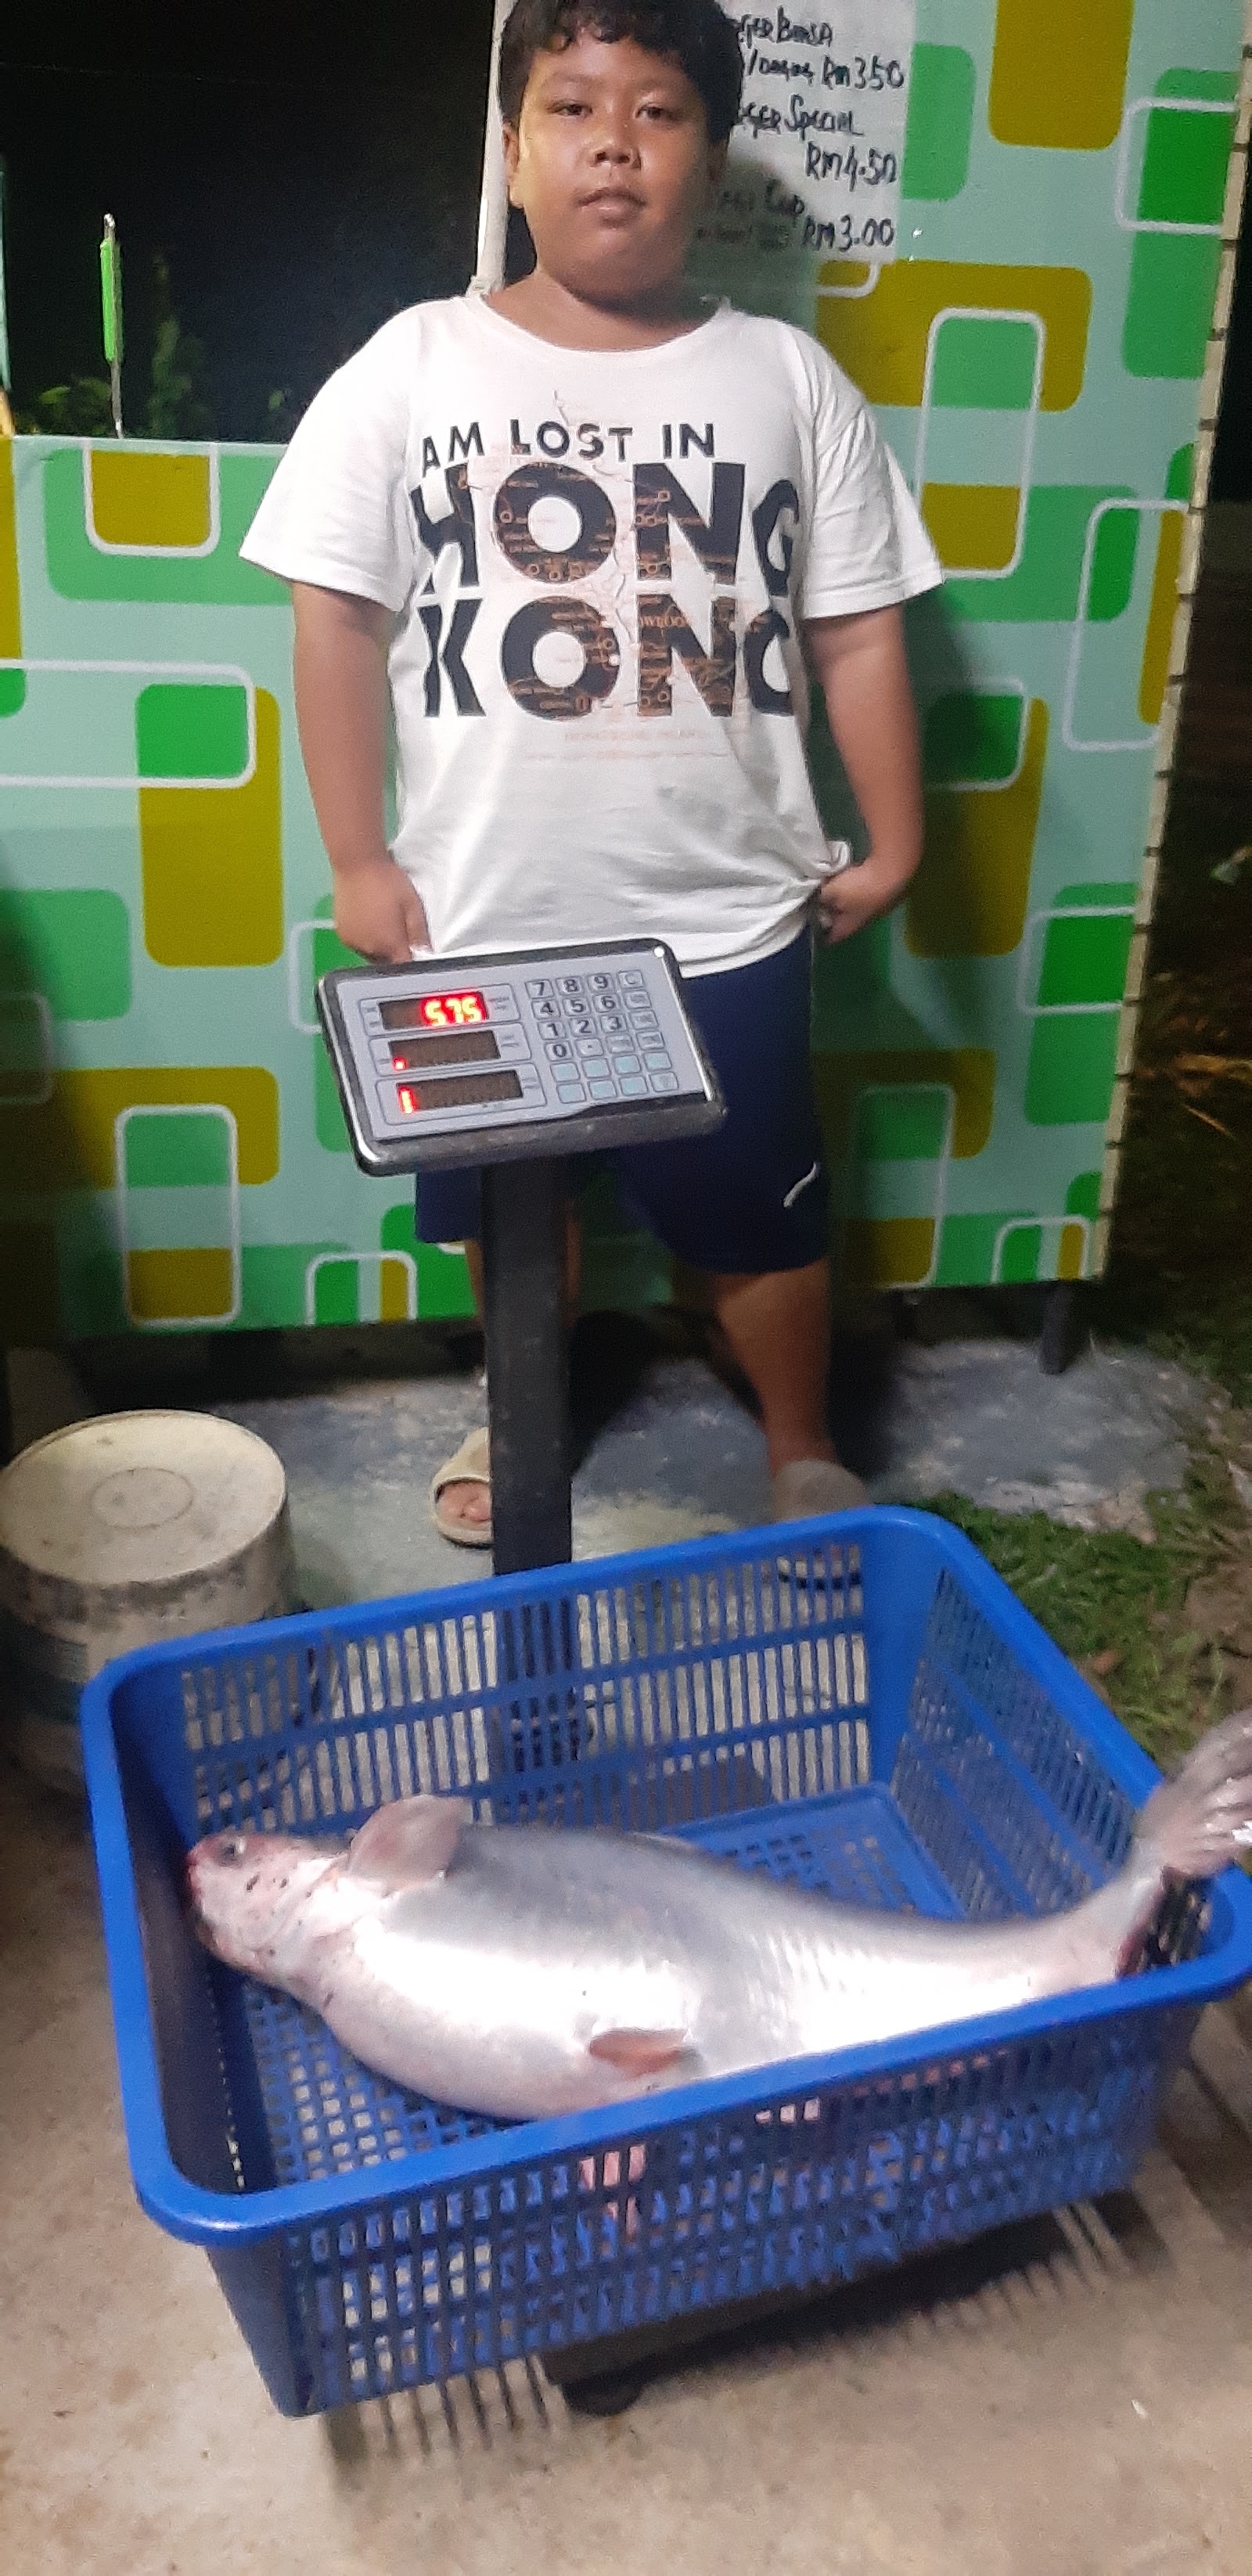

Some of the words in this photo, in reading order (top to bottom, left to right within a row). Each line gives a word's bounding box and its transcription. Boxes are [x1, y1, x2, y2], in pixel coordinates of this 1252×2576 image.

[422, 421, 486, 479] AM
[509, 419, 633, 462] LOST
[663, 422, 715, 459] IN
[409, 462, 800, 596] HONG
[533, 981, 545, 996] 7
[563, 979, 579, 993] 8
[594, 975, 609, 990] 9
[540, 1002, 555, 1015] 4
[570, 998, 585, 1013] 5
[601, 995, 617, 1010] 6
[547, 1022, 559, 1037] 1
[577, 1019, 592, 1034] 2
[608, 1016, 622, 1031] 3
[552, 1044, 567, 1058] 0
